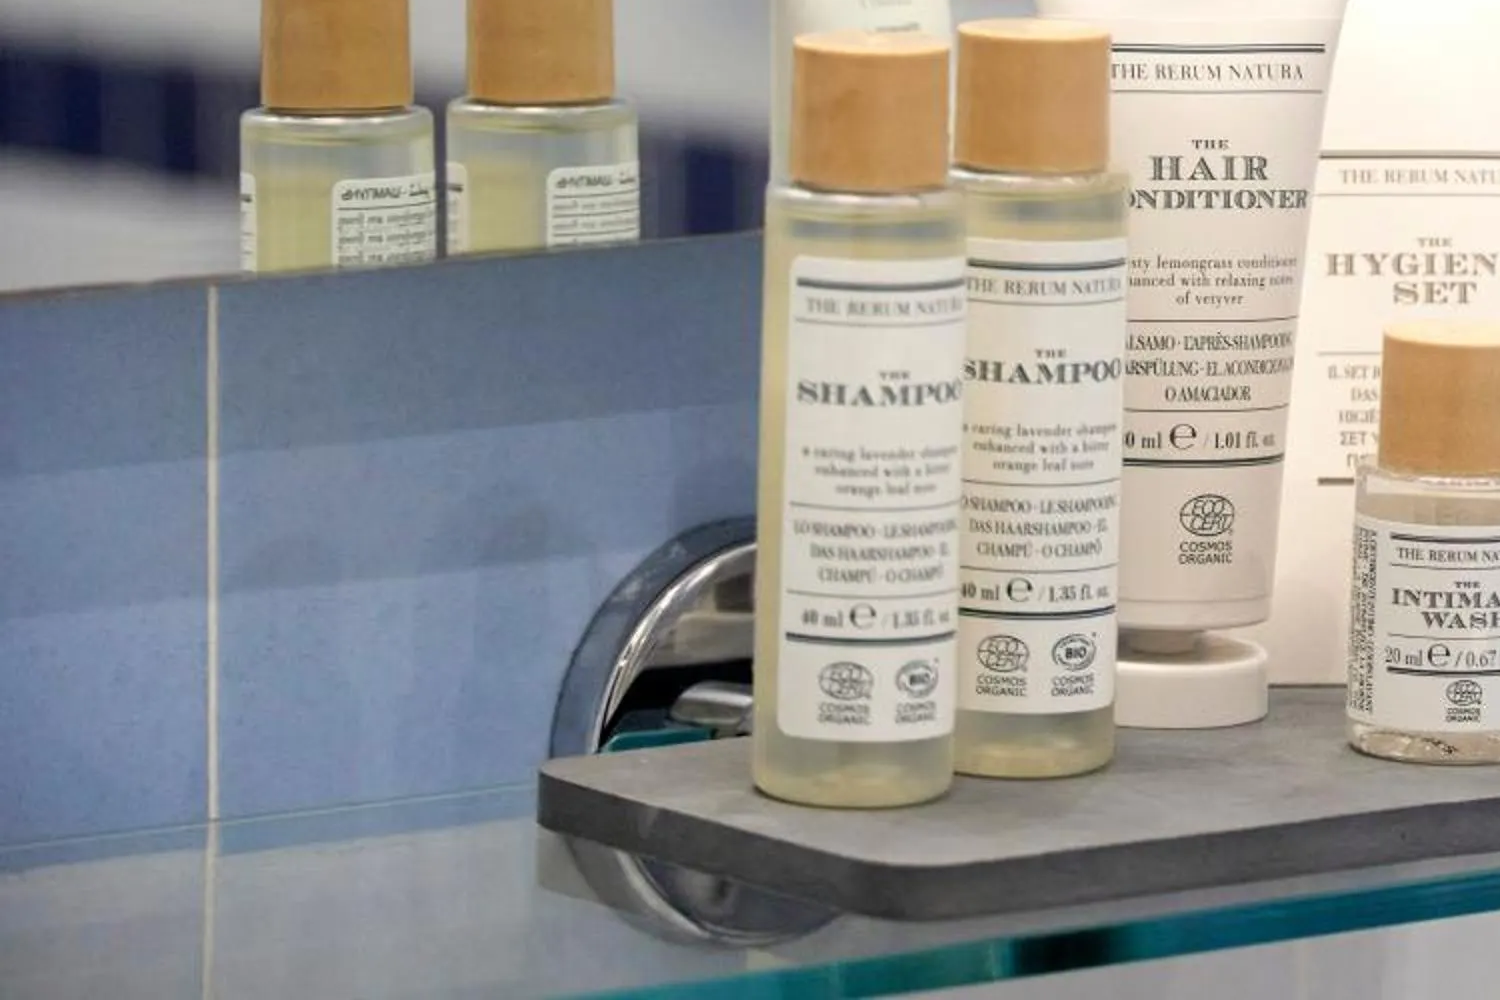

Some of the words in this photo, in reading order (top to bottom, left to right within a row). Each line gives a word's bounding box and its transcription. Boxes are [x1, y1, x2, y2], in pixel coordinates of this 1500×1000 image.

[1111, 63, 1148, 80] THE
[1155, 63, 1221, 81] RERUM
[1228, 63, 1304, 80] NATURA
[1191, 138, 1230, 150] THE
[1149, 154, 1268, 181] HAIR
[1339, 168, 1379, 185] THE
[1384, 168, 1449, 185] RERUM
[1129, 188, 1308, 210] NDITIONER
[1417, 237, 1453, 248] THE
[1130, 258, 1150, 273] sty
[1157, 255, 1233, 273] lemongrass
[1003, 278, 1067, 297] RERUM
[1129, 273, 1175, 287] anced
[1181, 273, 1211, 287] with
[1215, 273, 1265, 290] relaxing
[1175, 289, 1192, 305] of
[1393, 281, 1478, 305] SET
[1126, 333, 1176, 350] LSAMO
[1033, 348, 1067, 359] THE
[1165, 386, 1177, 401] O
[1178, 385, 1252, 401] AMACIADOR
[1141, 431, 1162, 449] ml
[1214, 431, 1241, 449] 1.01
[992, 459, 1038, 475] orange
[1042, 457, 1067, 471] leaf
[1179, 541, 1233, 553] COSMOS
[1396, 546, 1424, 561] THE
[1429, 549, 1478, 562] RERUM
[1178, 553, 1233, 565] ORGANIC
[980, 584, 1000, 601] ml
[1048, 585, 1077, 603] 1.35
[1454, 581, 1480, 589] THE
[823, 608, 844, 628] ml
[1065, 646, 1087, 659] BIO
[1385, 645, 1401, 664] 20
[1405, 649, 1423, 666] ml
[1466, 649, 1497, 667] 0.67
[976, 674, 1028, 686] COSMOS
[975, 685, 1028, 697] ORGANIC
